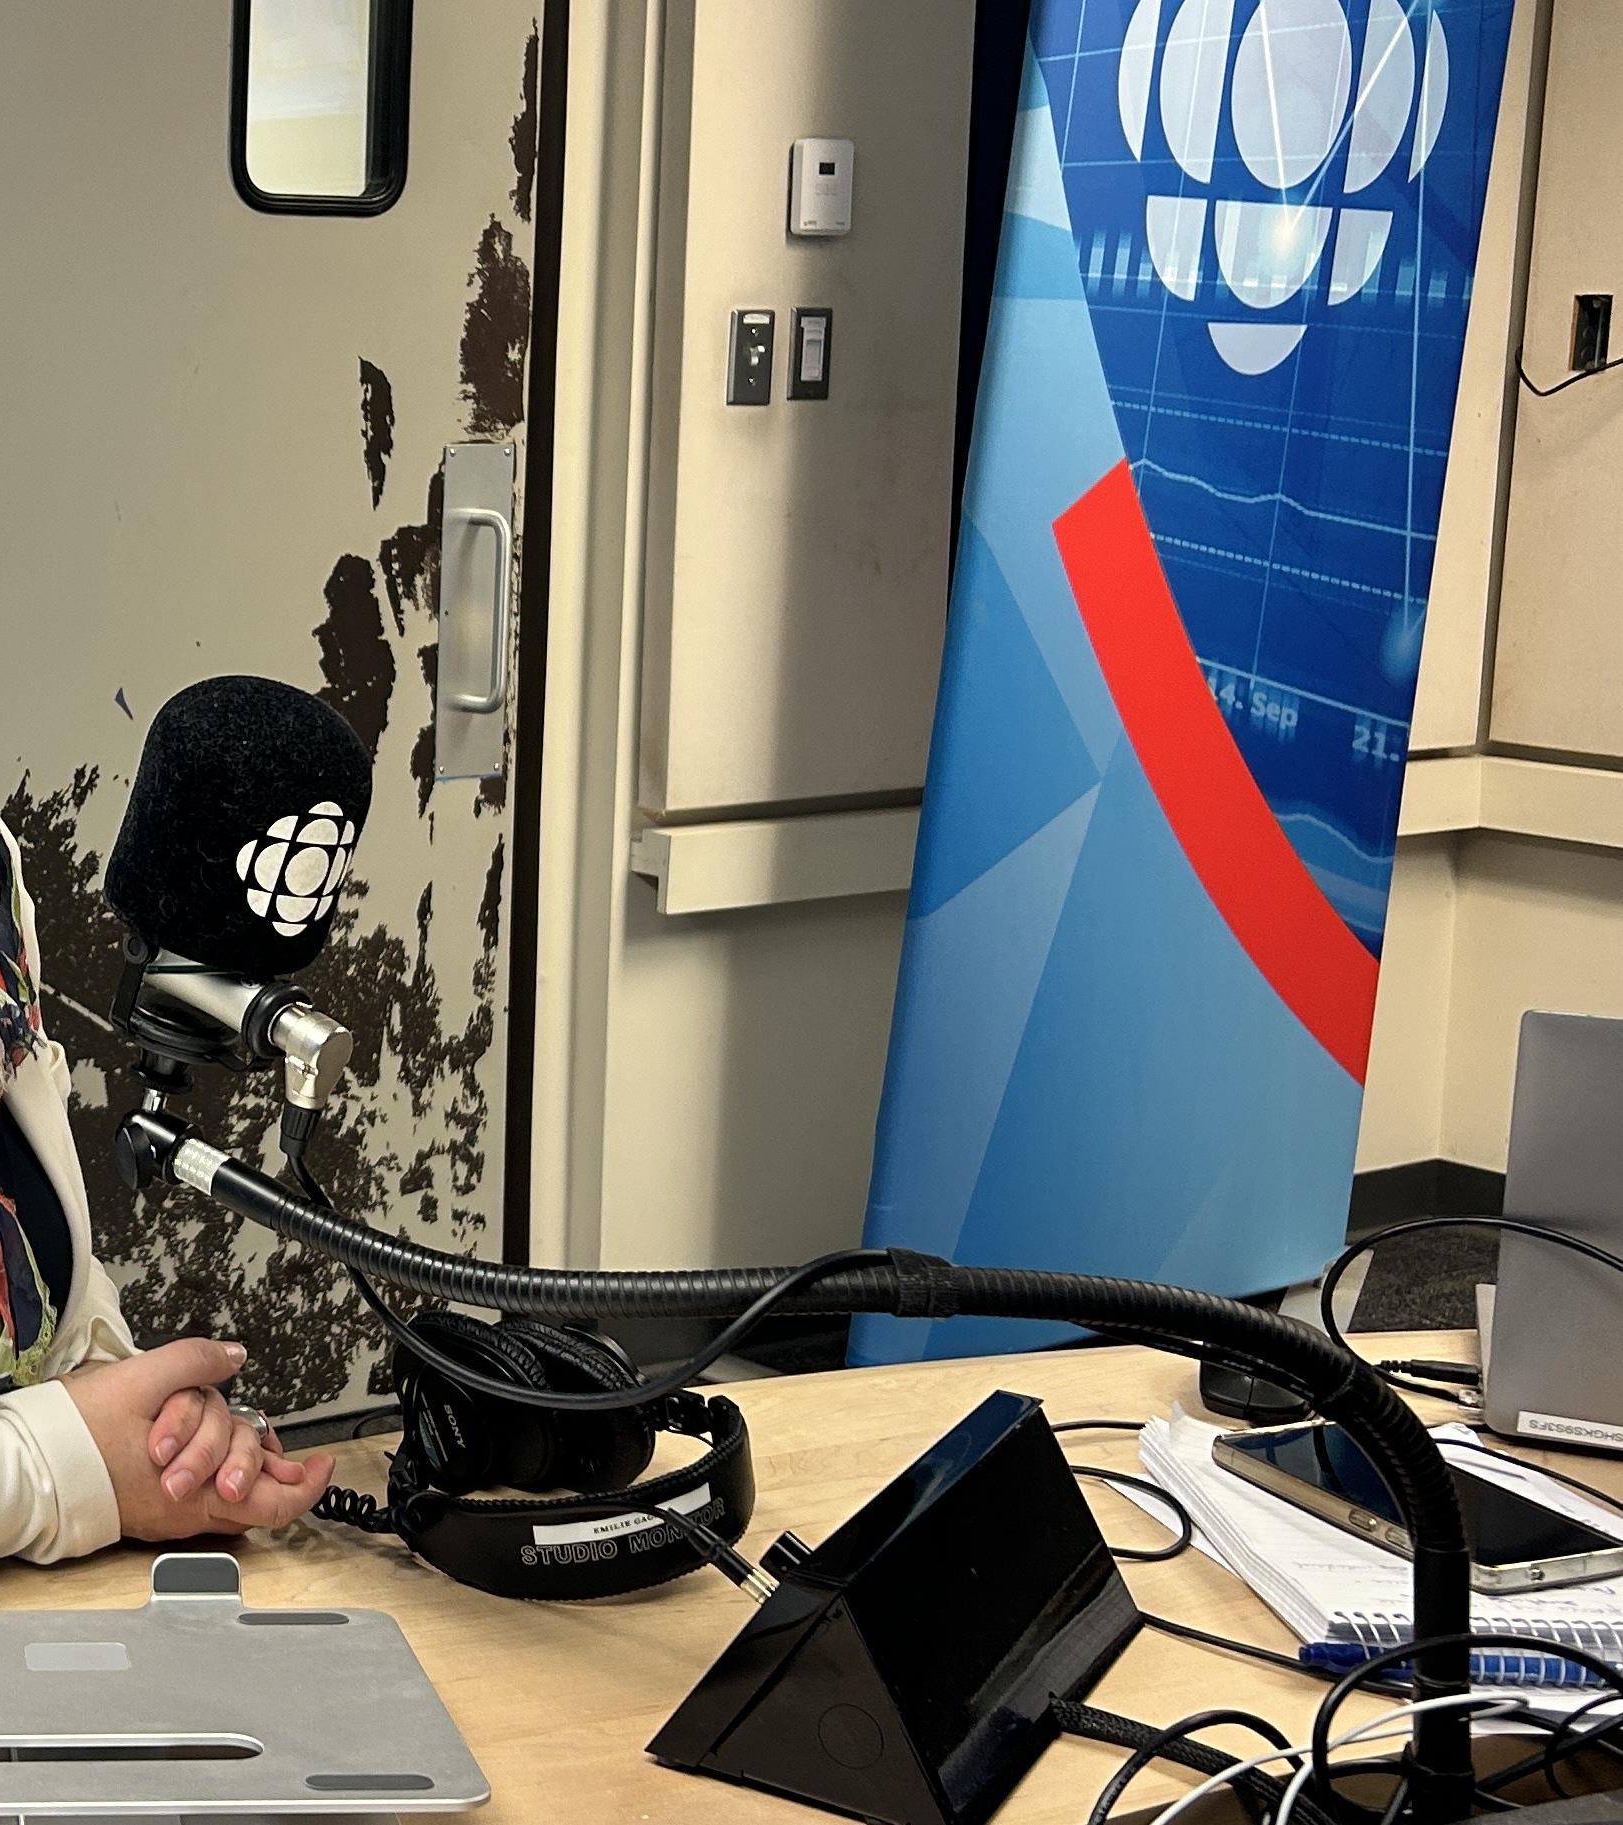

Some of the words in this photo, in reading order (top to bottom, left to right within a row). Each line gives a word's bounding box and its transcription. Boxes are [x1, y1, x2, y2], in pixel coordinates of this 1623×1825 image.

[1250, 691, 1298, 730] Sep
[1352, 724, 1400, 762] 21.
[443, 1404, 466, 1448] SONY
[521, 1539, 618, 1566] STUDIO
[628, 1497, 726, 1554] MONTOR
[593, 1520, 632, 1535] EMILIE
